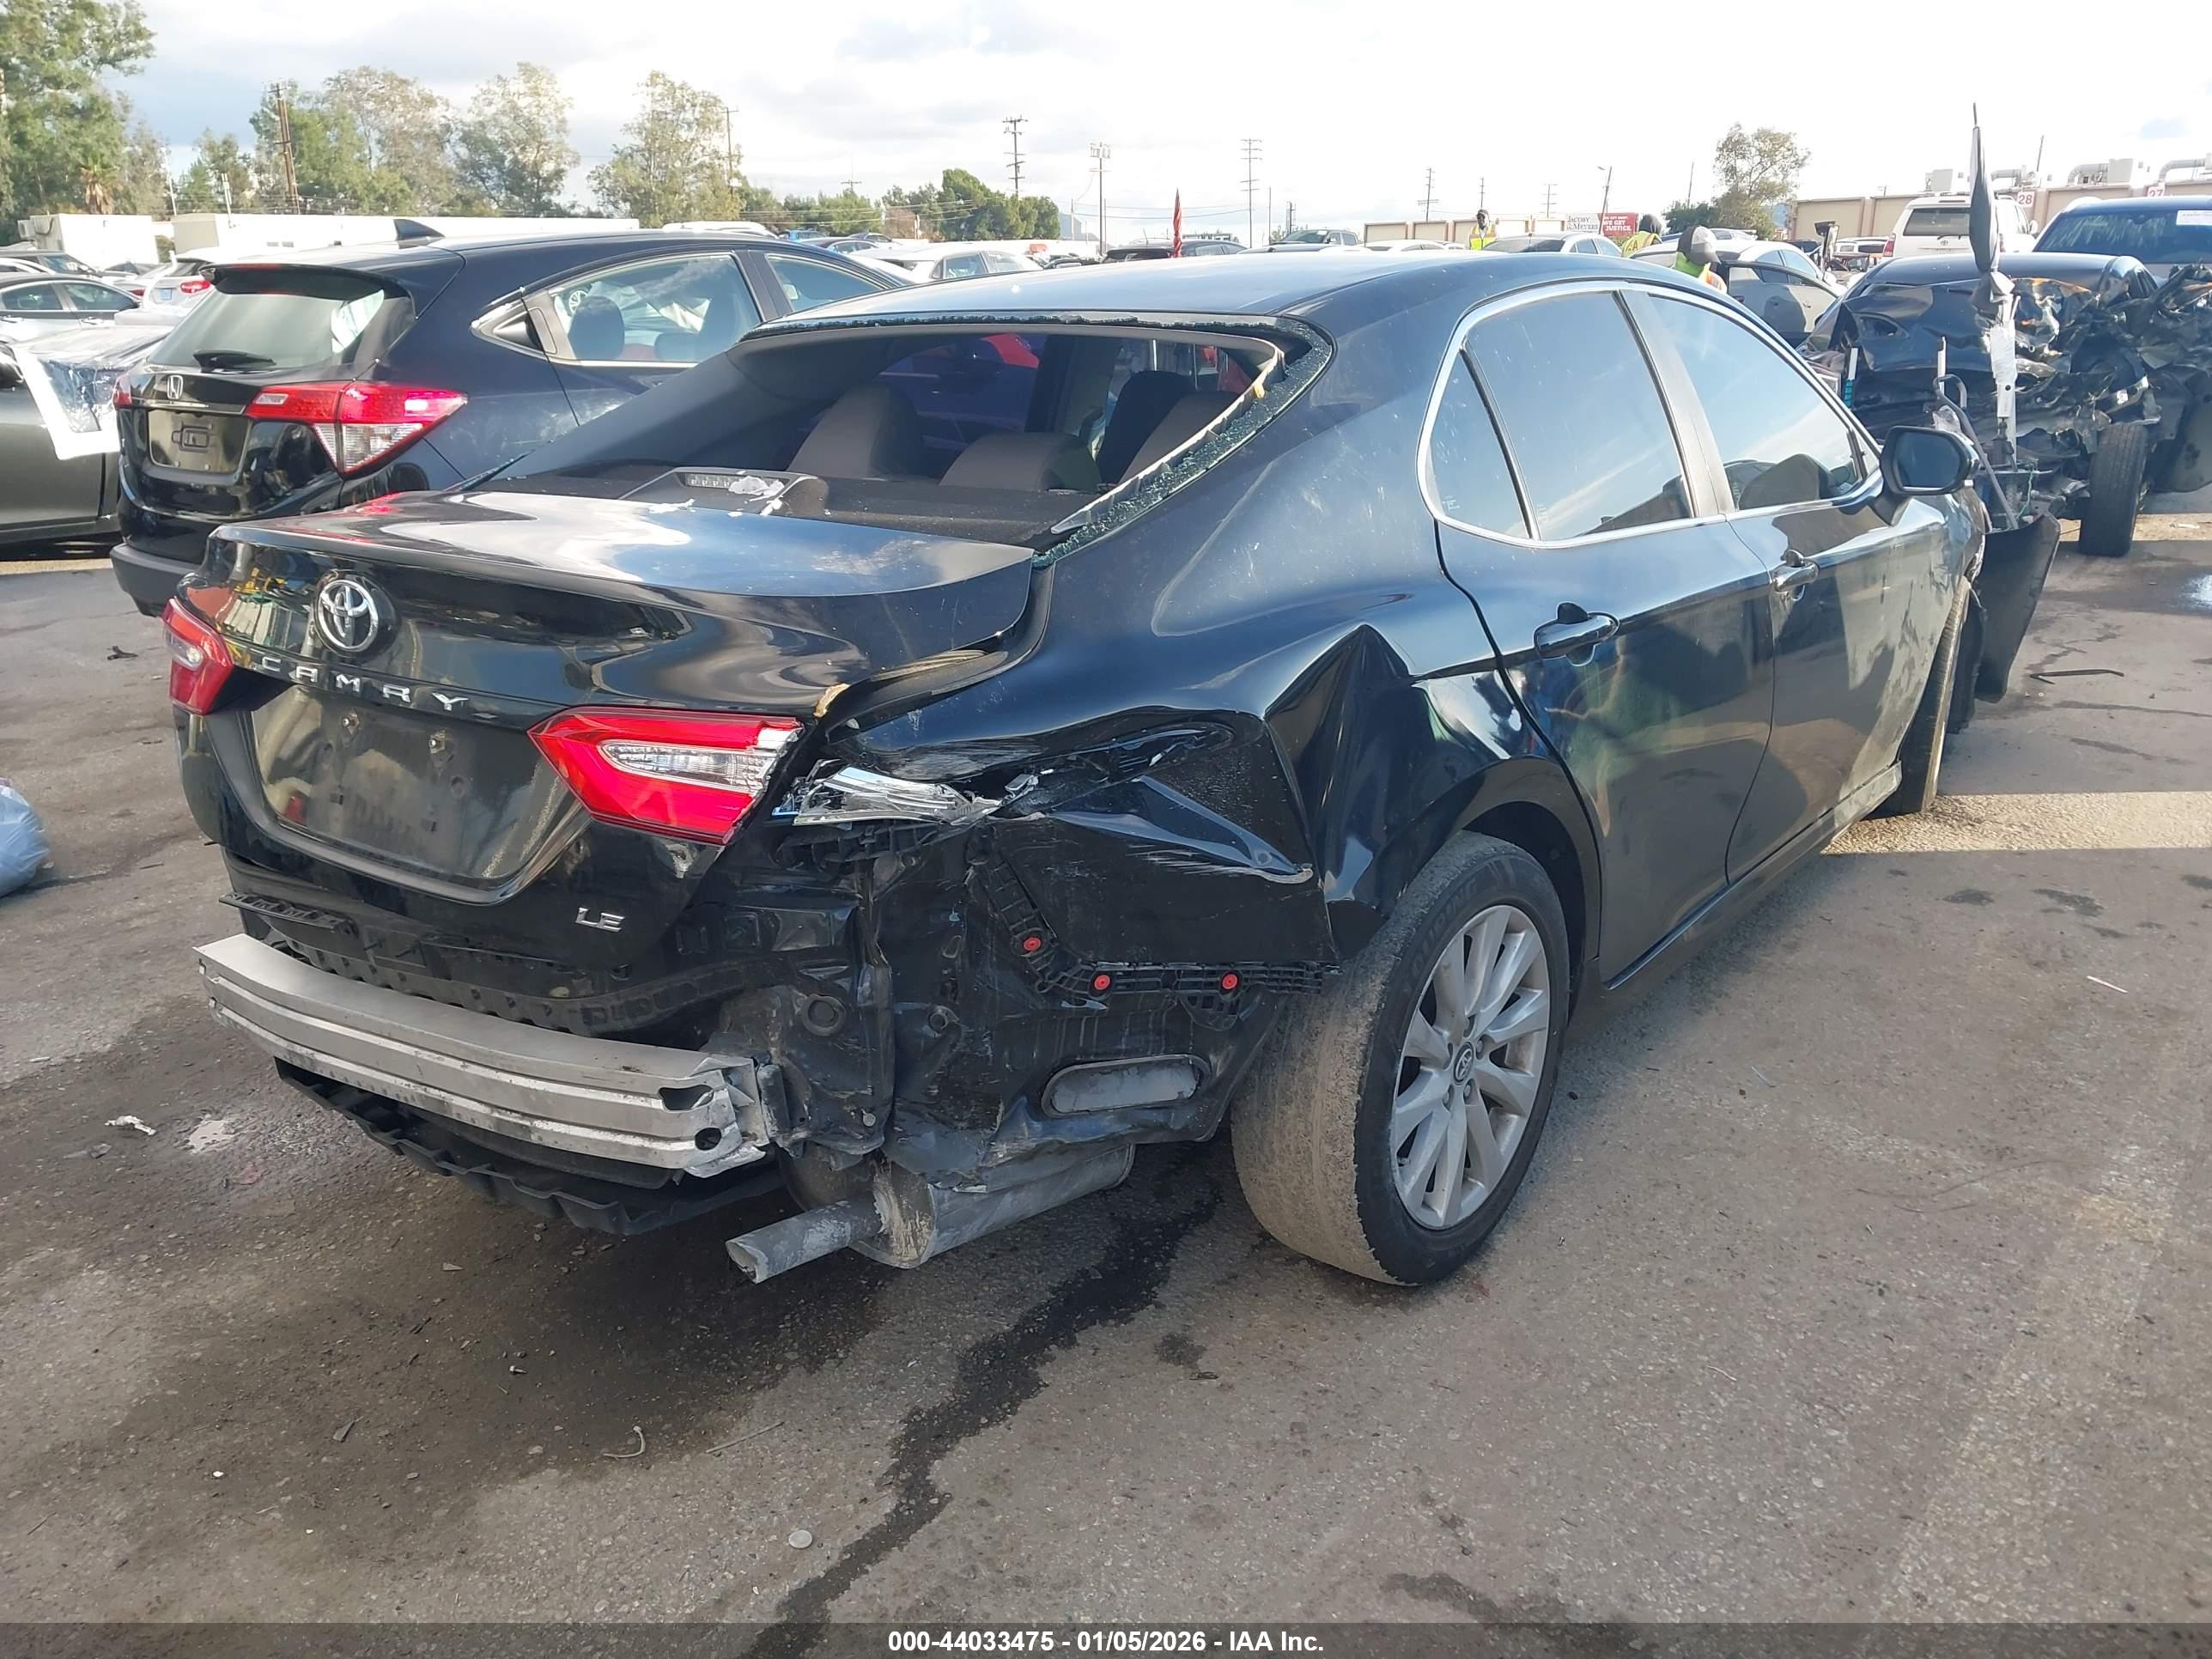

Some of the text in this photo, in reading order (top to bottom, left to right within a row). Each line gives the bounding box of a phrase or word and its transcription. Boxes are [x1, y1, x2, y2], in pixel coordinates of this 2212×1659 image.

[2019, 194, 2033, 204] 28
[262, 656, 469, 711] CAMRY
[575, 907, 625, 933] LE
